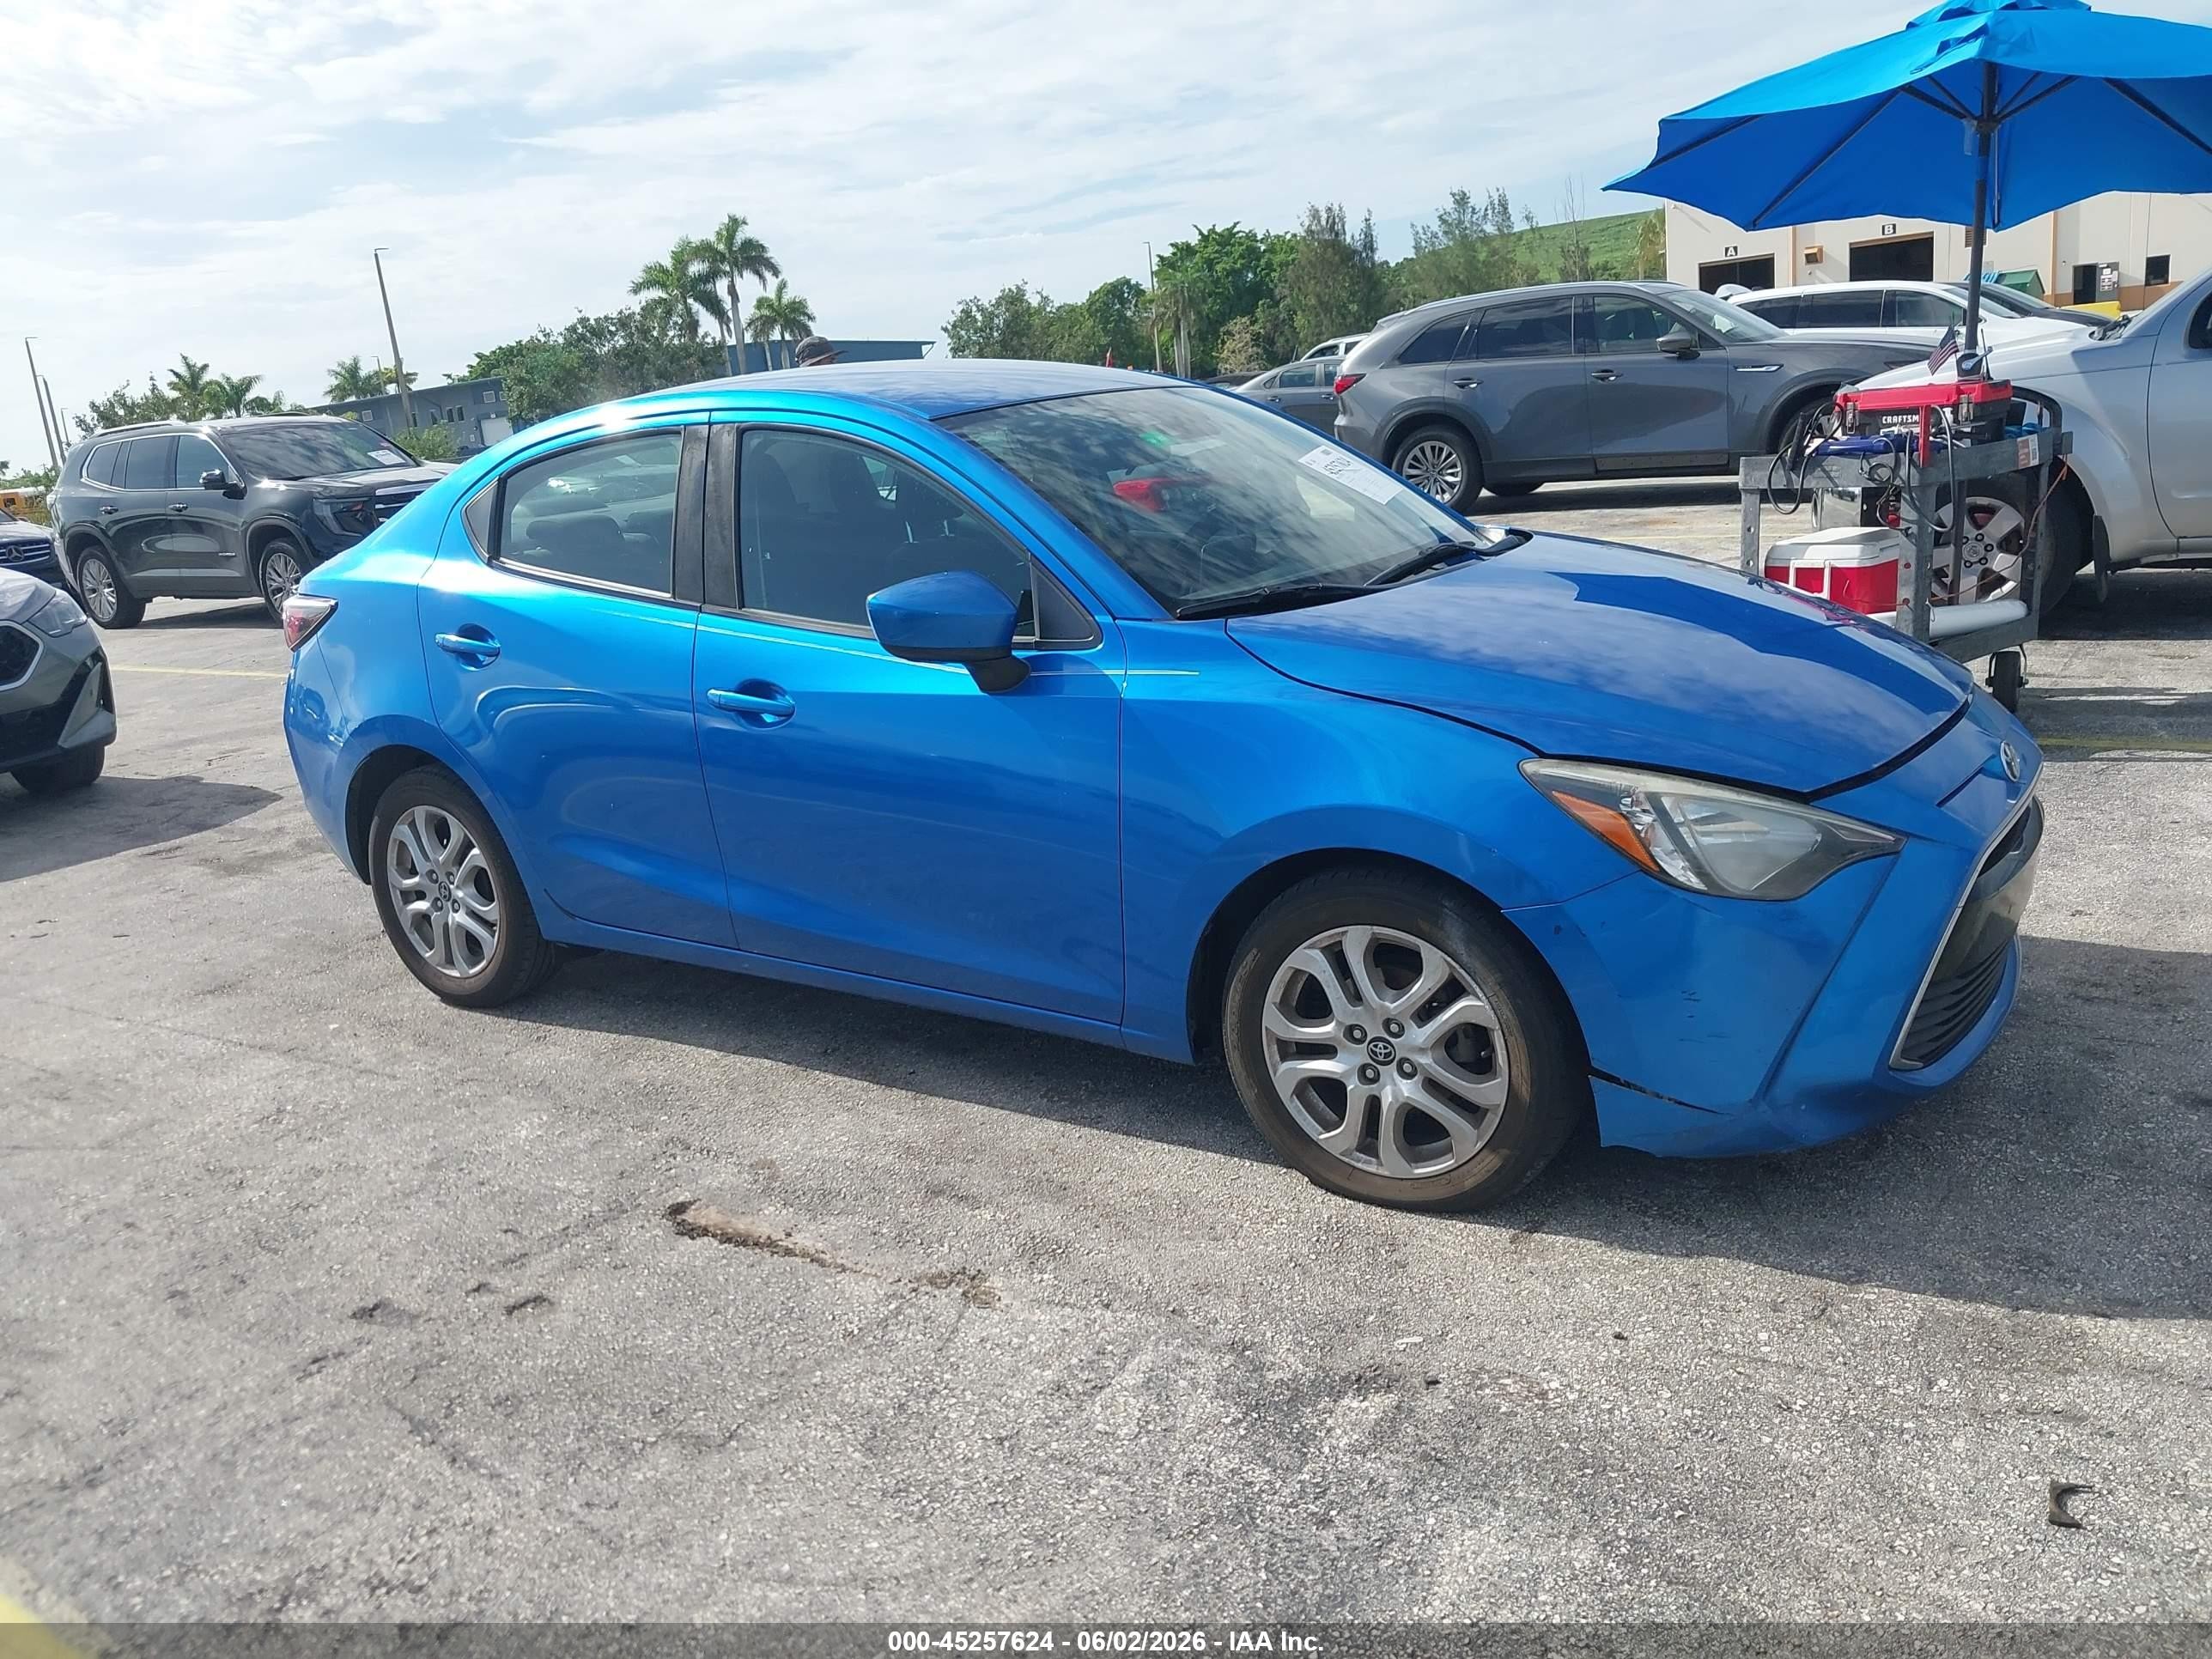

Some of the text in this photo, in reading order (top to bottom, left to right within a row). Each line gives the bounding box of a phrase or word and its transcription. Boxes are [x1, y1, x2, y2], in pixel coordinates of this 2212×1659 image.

[1884, 224, 1894, 234] B
[1726, 246, 1736, 257] A
[1881, 415, 1920, 424] CRAFTSM
